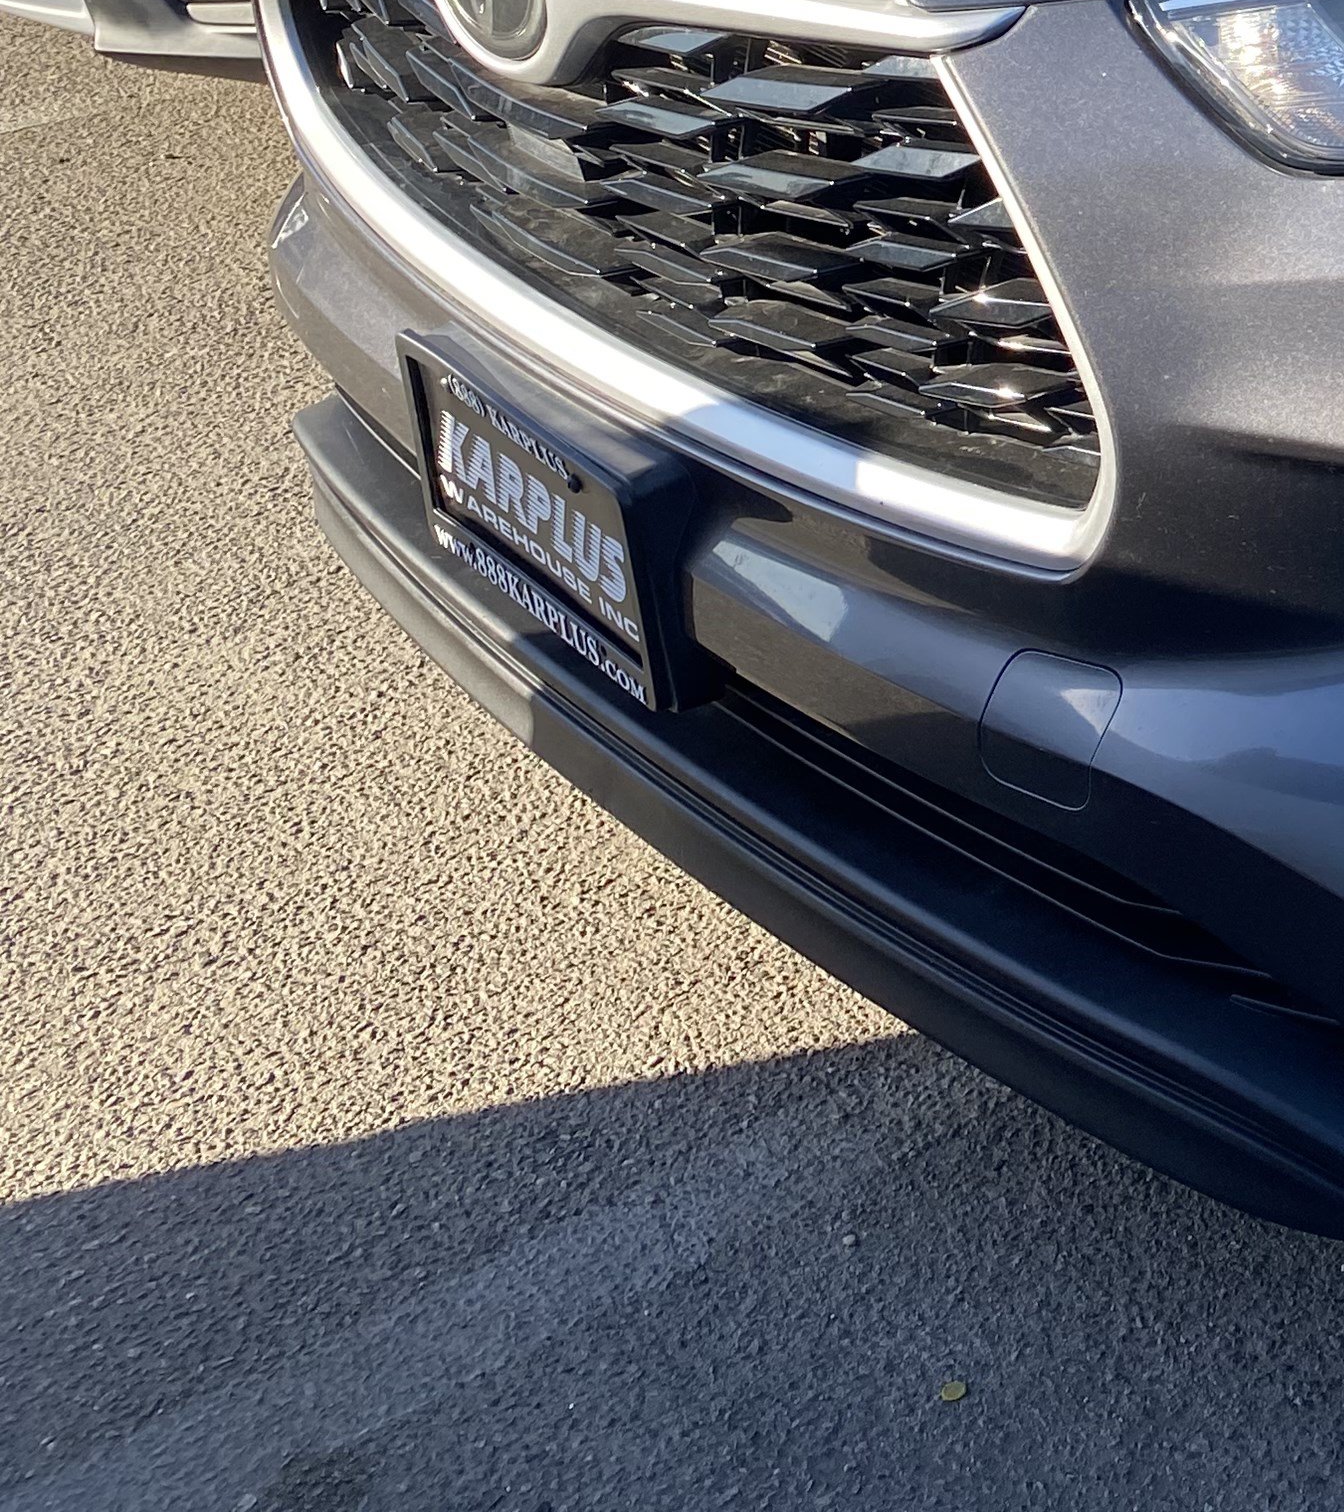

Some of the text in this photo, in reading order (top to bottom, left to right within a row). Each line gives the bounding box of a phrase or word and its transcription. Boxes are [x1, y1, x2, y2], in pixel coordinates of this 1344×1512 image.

[436, 409, 628, 604] KARPLUS
[486, 404, 568, 479] KARPLUS
[439, 474, 640, 642] WAREHOUSE INC
